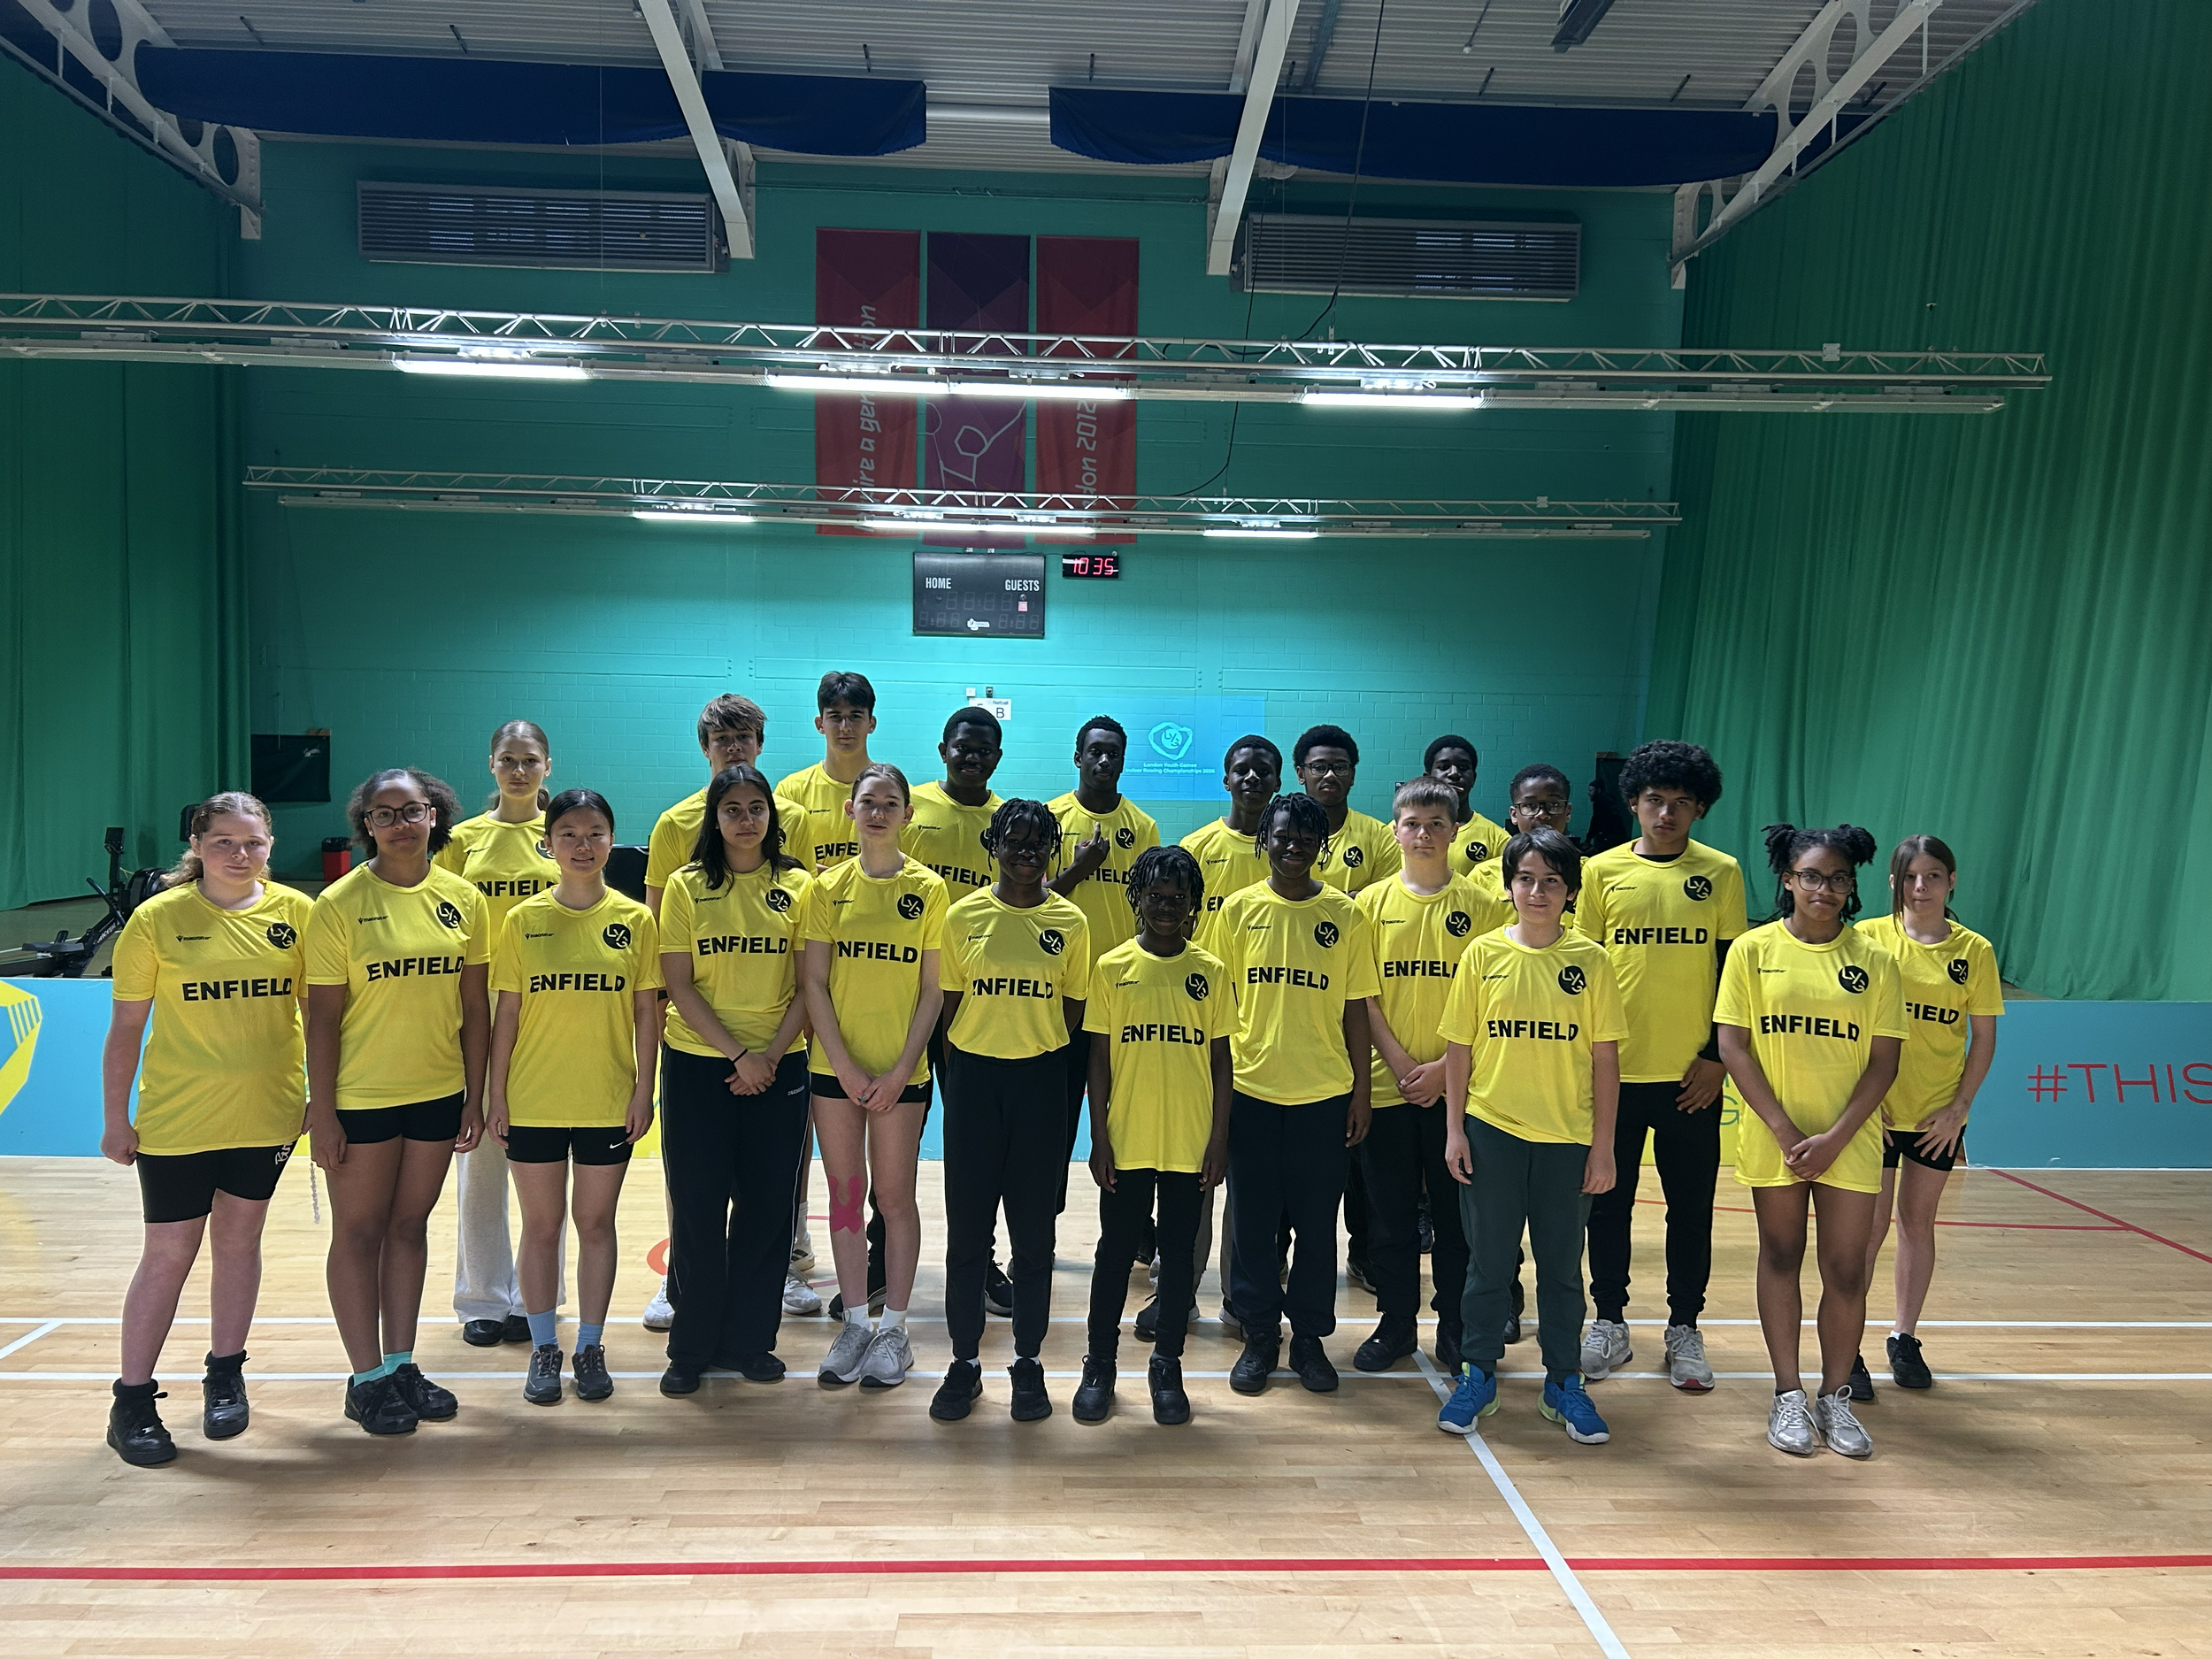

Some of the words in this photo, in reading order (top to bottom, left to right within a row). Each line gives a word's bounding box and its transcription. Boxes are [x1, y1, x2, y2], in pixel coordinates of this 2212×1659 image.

[854, 304, 881, 433] gention
[1076, 399, 1097, 452] 2012
[859, 437, 875, 452] a
[926, 577, 952, 589] HOME
[1004, 580, 1040, 592] GUESTS
[996, 707, 1005, 718] B
[815, 841, 858, 860] ENFE
[924, 864, 991, 887] NFIELD
[473, 879, 555, 896] NFIEL
[696, 935, 788, 956] ENFIELD
[1614, 927, 1709, 944] ENFIELD
[836, 941, 918, 964] NFIELD
[365, 956, 465, 981] ENFIELD
[1248, 966, 1329, 990] ENFIELD
[181, 978, 293, 1002] ENFIELD
[529, 973, 626, 993] ENFIELD
[972, 977, 1054, 999] ENFIELD
[1905, 1002, 1960, 1025] FIELD
[1121, 1024, 1205, 1046] ENFIELD
[1486, 1020, 1578, 1041] ENFIELD
[1760, 1014, 1860, 1042] ENFIELD
[2026, 1063, 2212, 1104] #THIS
